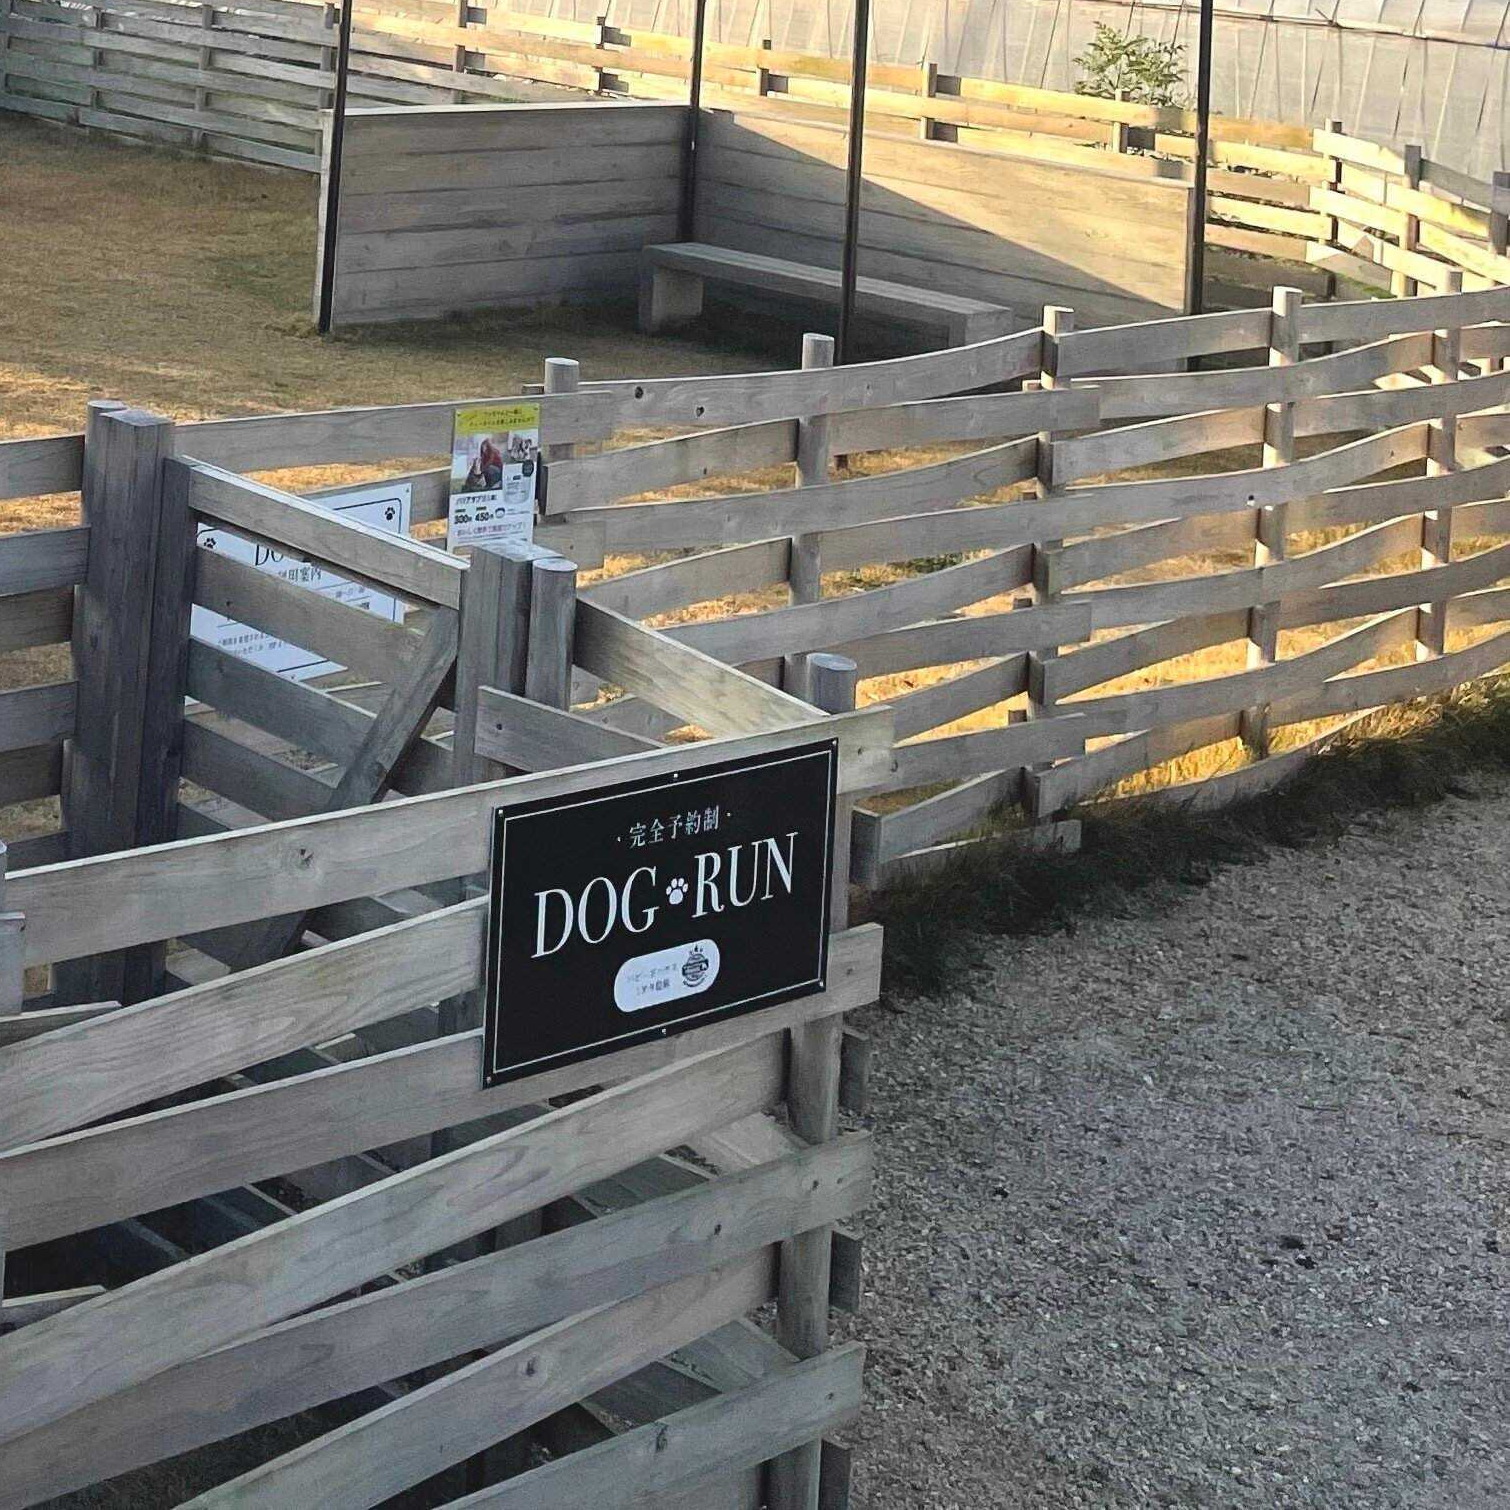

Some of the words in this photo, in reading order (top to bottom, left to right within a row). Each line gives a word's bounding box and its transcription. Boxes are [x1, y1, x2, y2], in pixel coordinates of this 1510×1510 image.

[629, 805, 720, 849] 完全予約制
[530, 866, 660, 959] DOG
[691, 831, 799, 919] RUN
